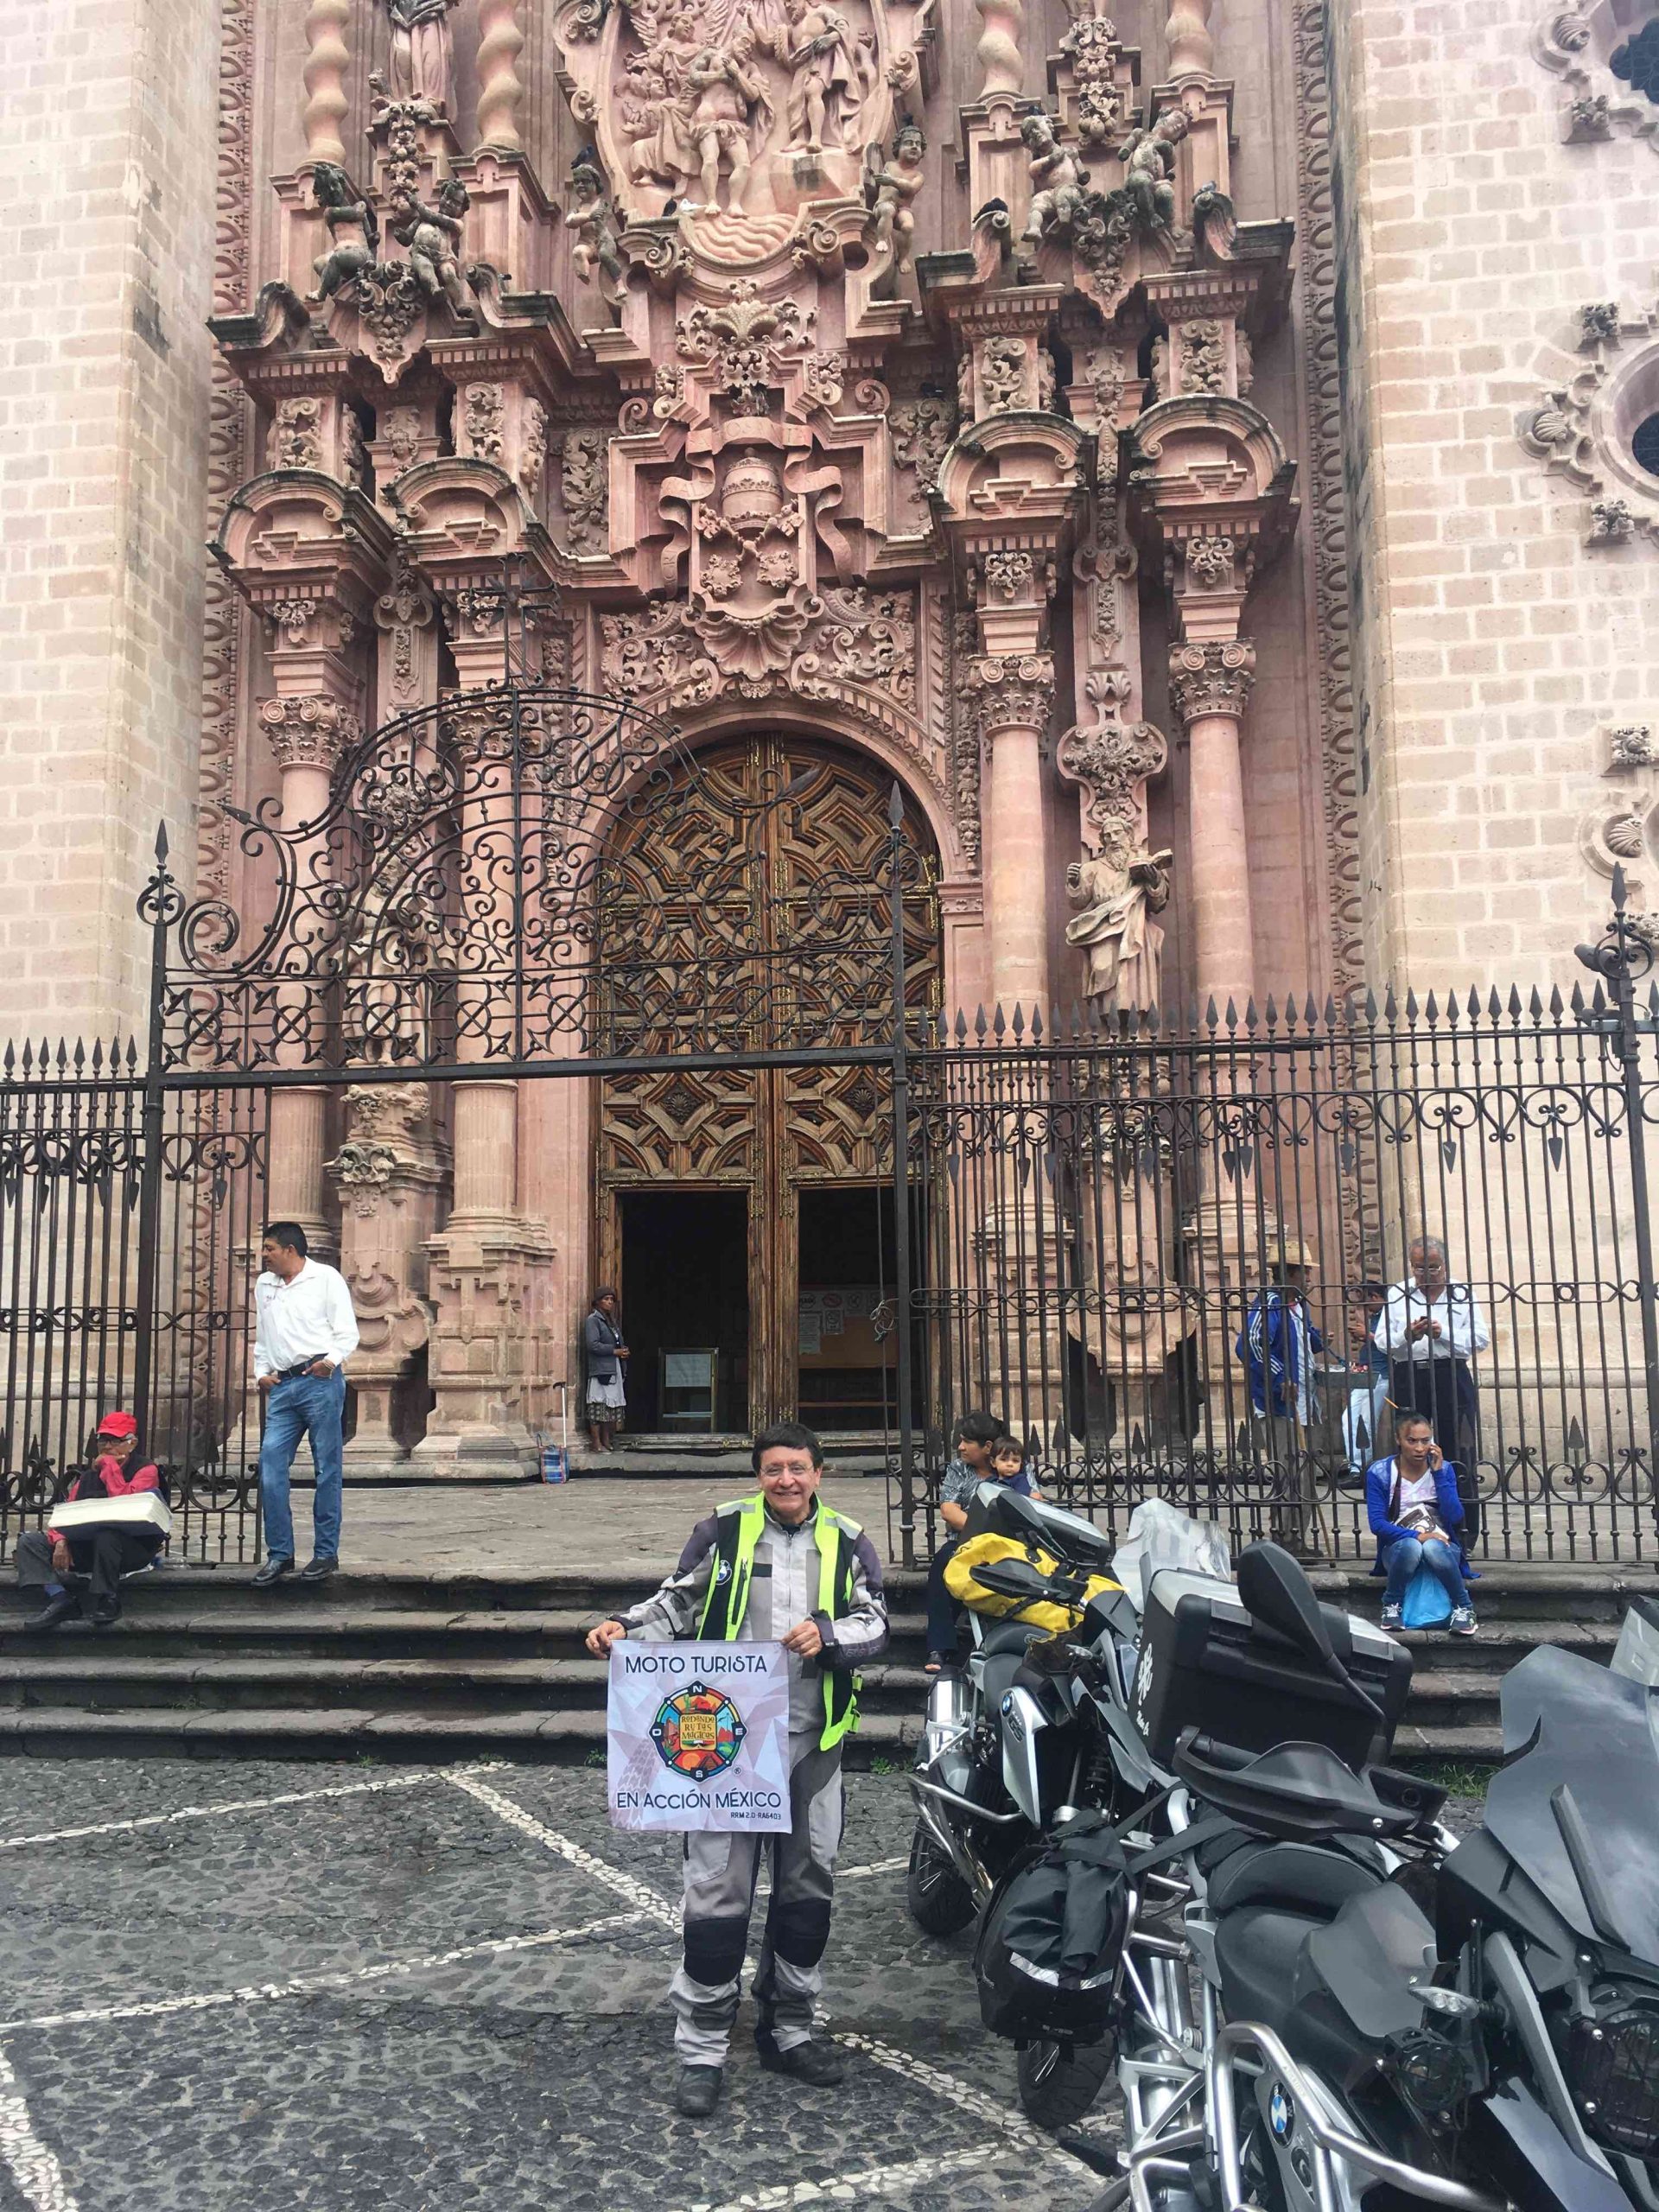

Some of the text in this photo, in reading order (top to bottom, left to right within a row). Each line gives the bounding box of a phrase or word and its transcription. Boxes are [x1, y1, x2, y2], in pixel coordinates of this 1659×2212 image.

[626, 1656, 767, 1673] MOTO TURISTA
[617, 1788, 781, 1809] EN ACCIÓN MÉXICO
